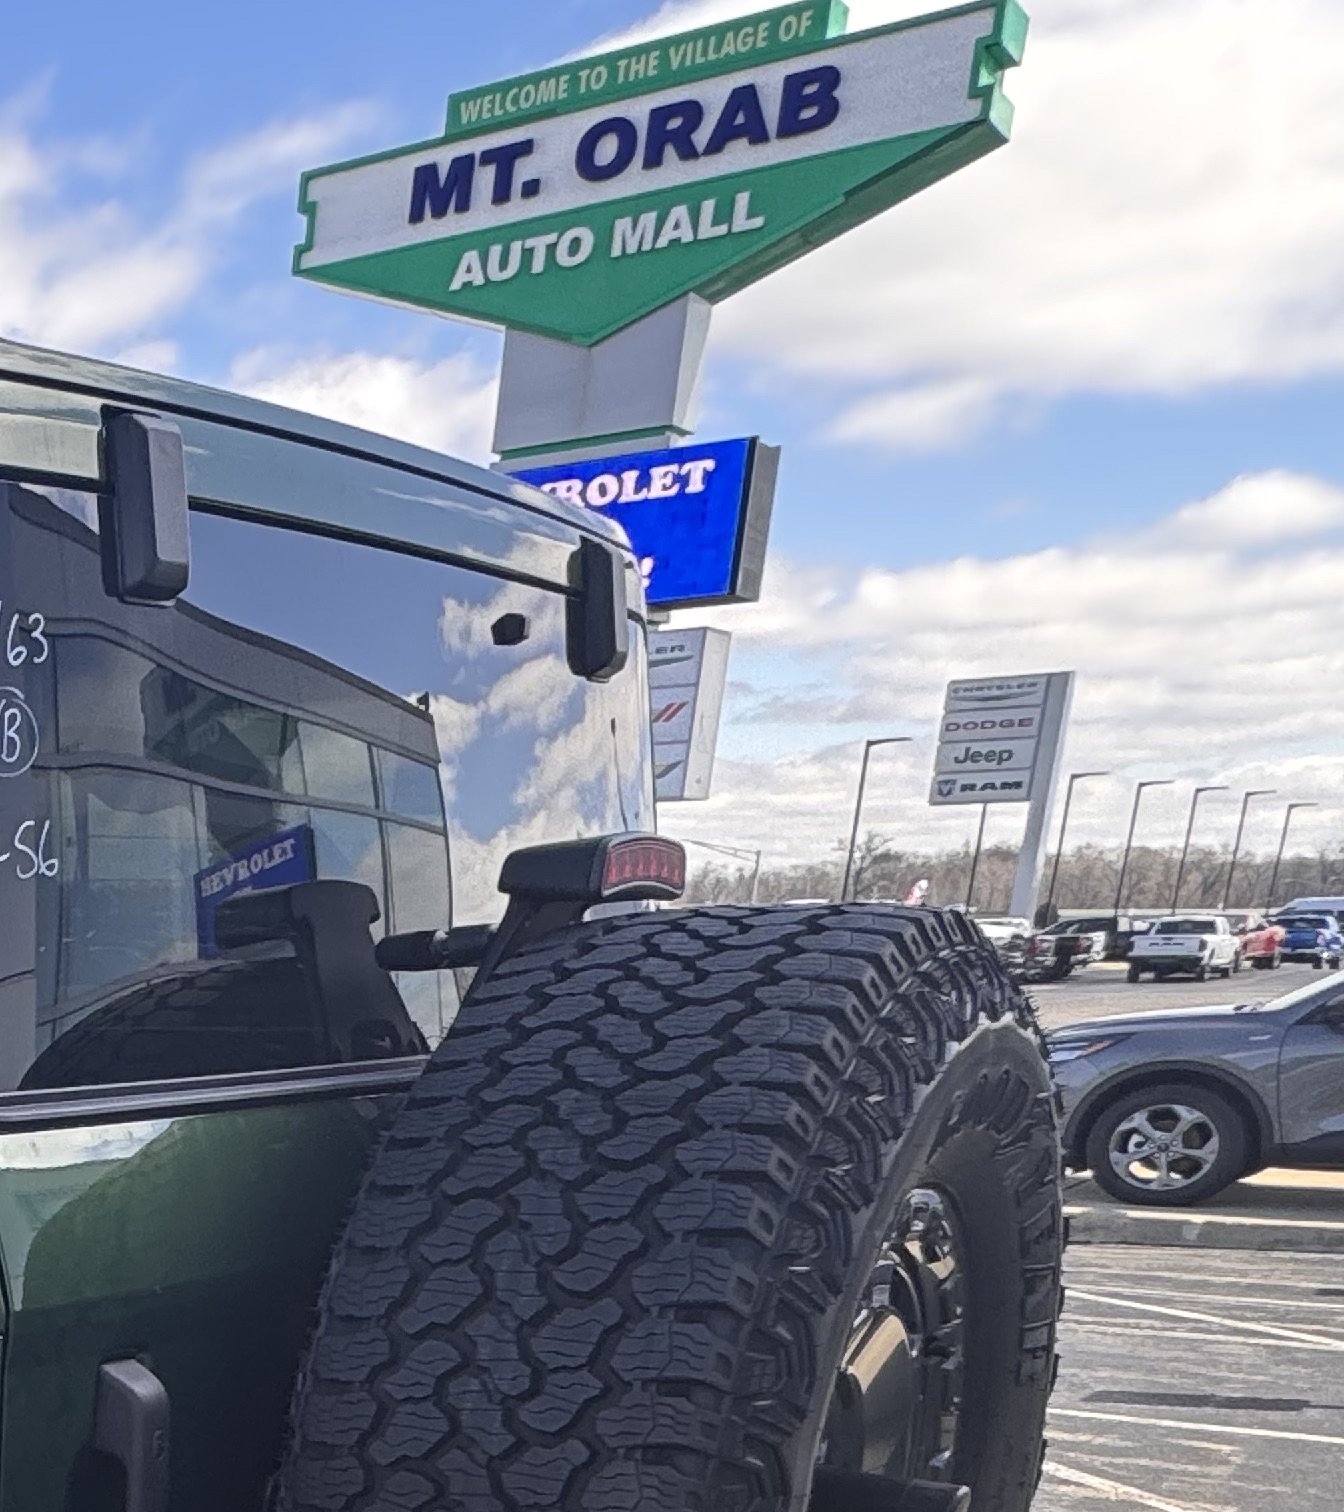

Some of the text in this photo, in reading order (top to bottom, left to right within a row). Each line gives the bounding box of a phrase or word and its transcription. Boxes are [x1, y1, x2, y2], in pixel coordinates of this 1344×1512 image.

[460, 10, 815, 125] WELCOME TO THE VILLAGE OF
[408, 65, 842, 225] MT. ORAB
[449, 191, 766, 292] AUTO MALL
[541, 458, 716, 508] ROLET
[945, 717, 1034, 732] DODGE
[954, 747, 1014, 765] Jeep
[960, 781, 1023, 792] RAM
[200, 838, 296, 898] HEVROLET
